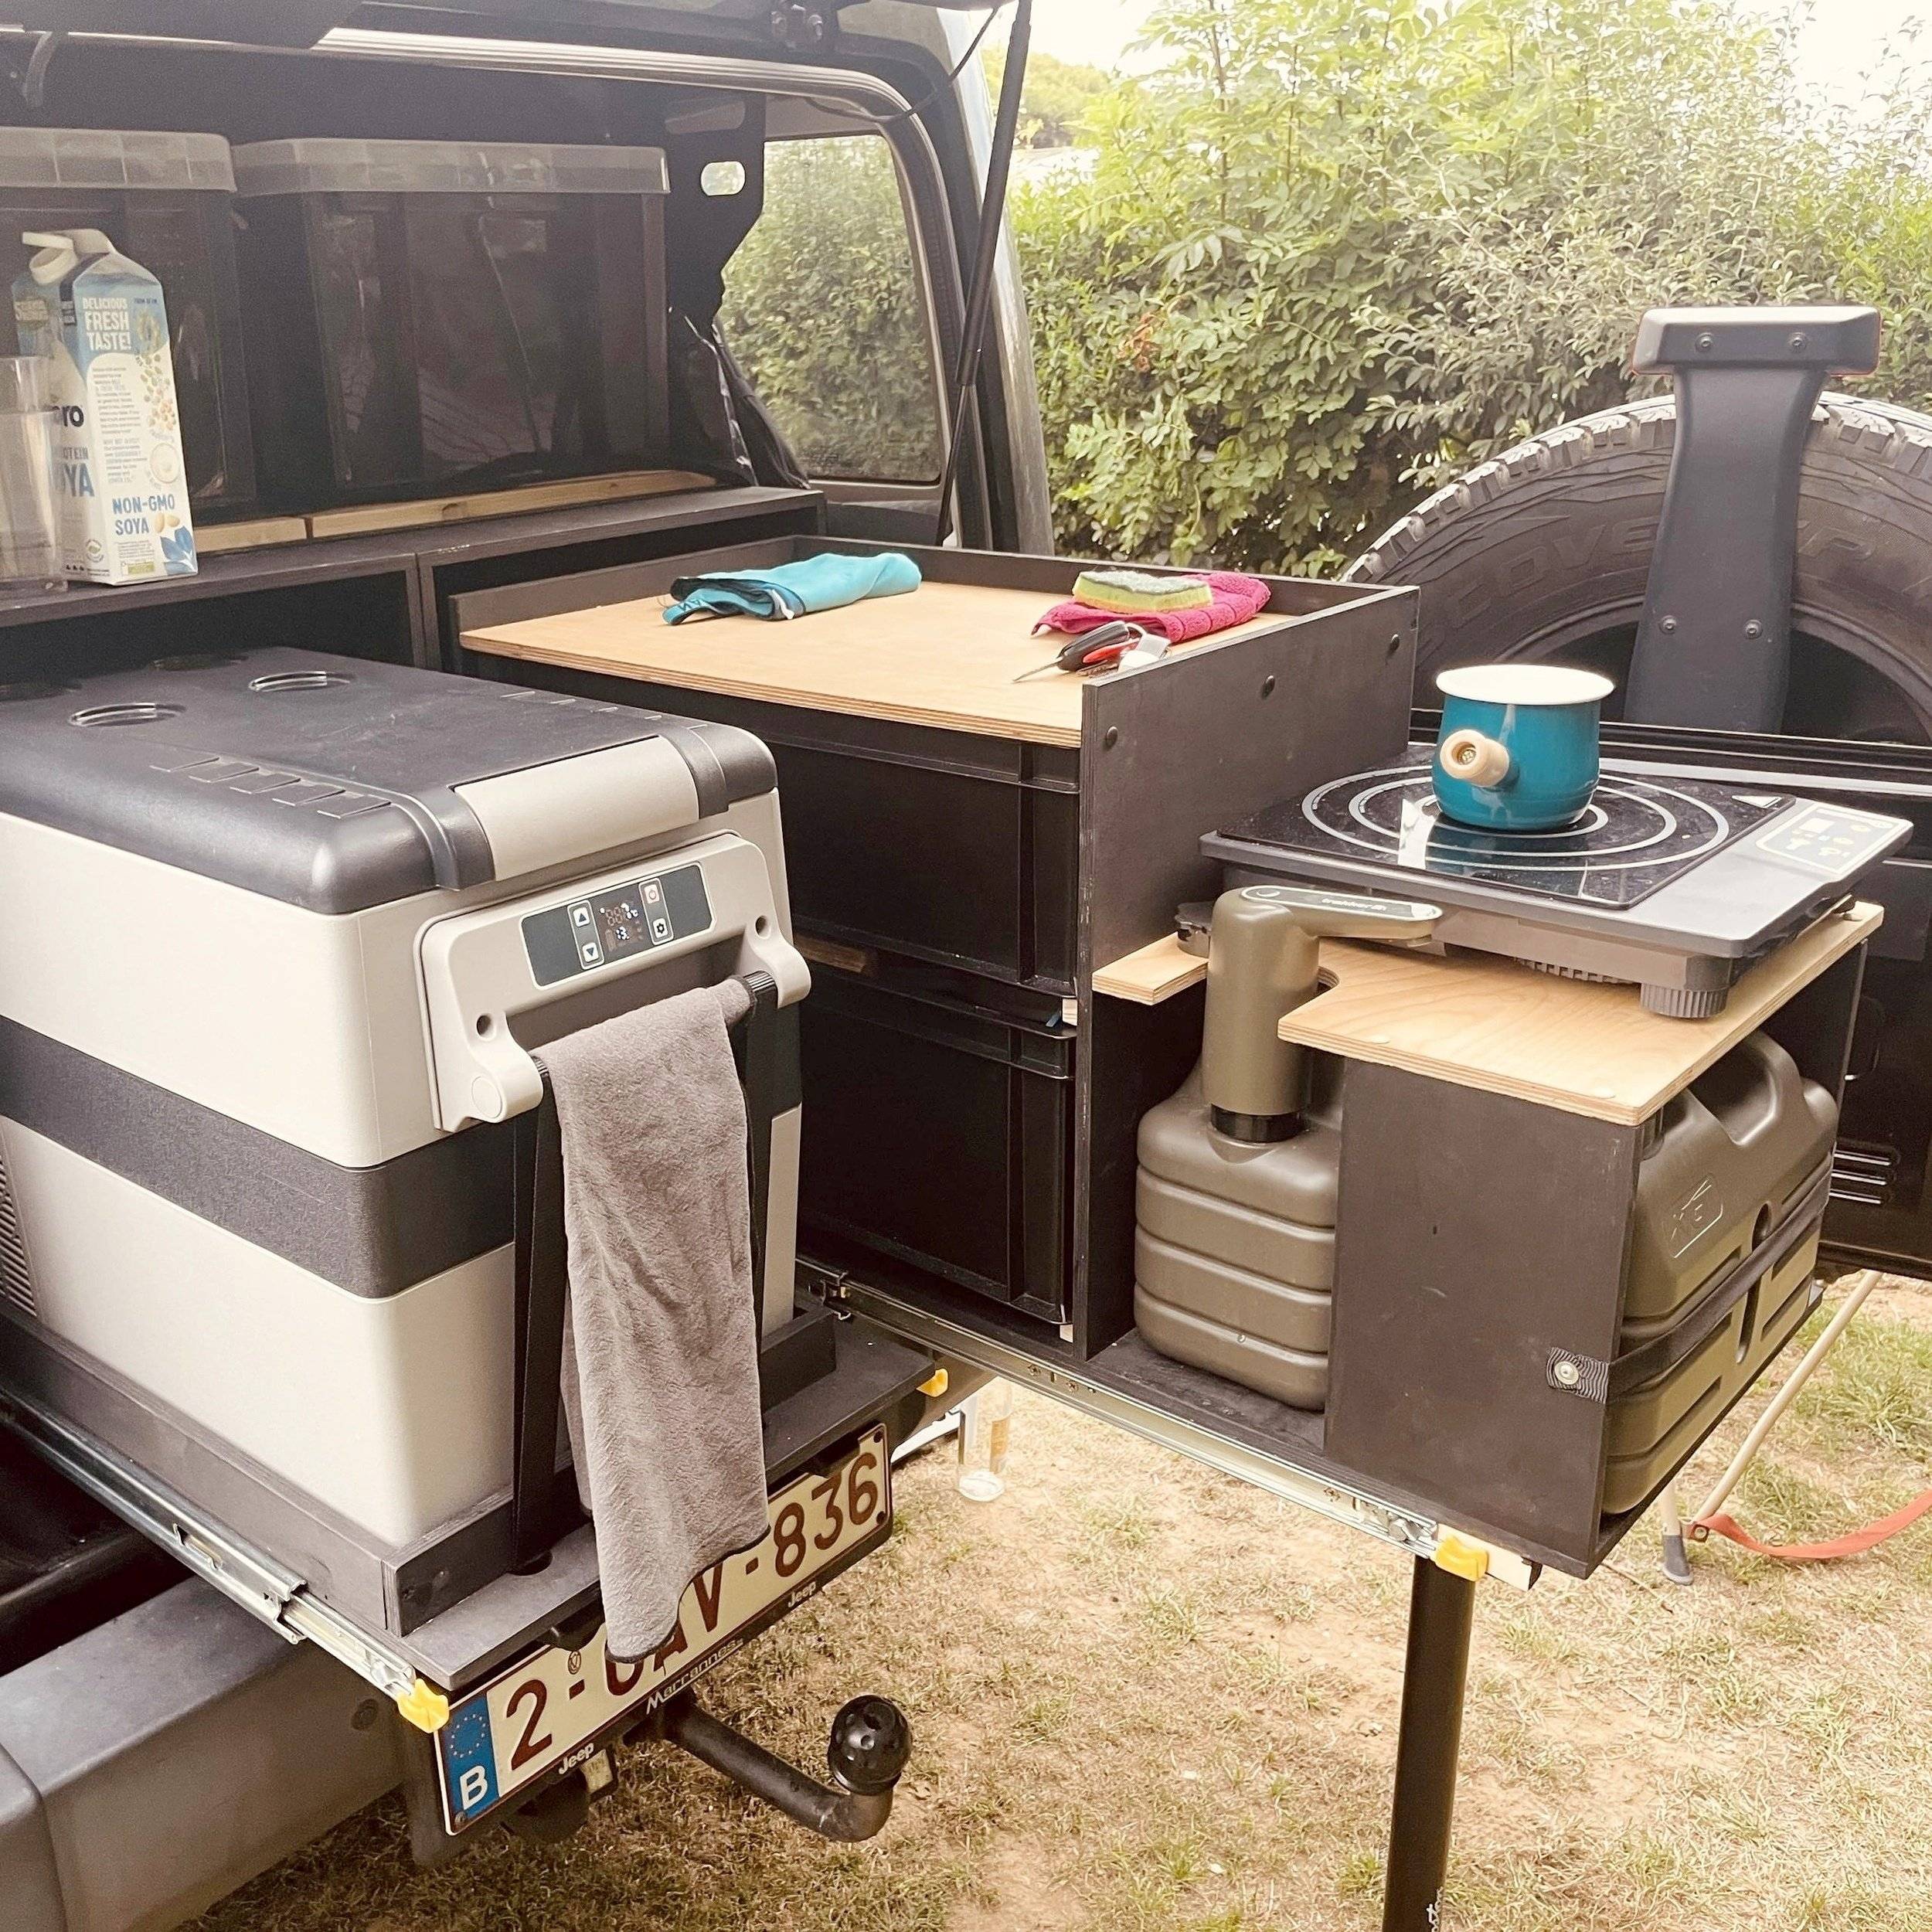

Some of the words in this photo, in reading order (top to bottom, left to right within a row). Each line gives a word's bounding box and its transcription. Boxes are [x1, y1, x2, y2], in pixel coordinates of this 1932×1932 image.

[85, 311, 130, 331] FRESH
[86, 332, 131, 351] TASTE!
[112, 494, 175, 515] NON-GMO
[115, 517, 150, 536] SOYA
[787, 1581, 817, 1608] Jeep
[558, 1743, 594, 1775] Jeep
[459, 1765, 488, 1811] B
